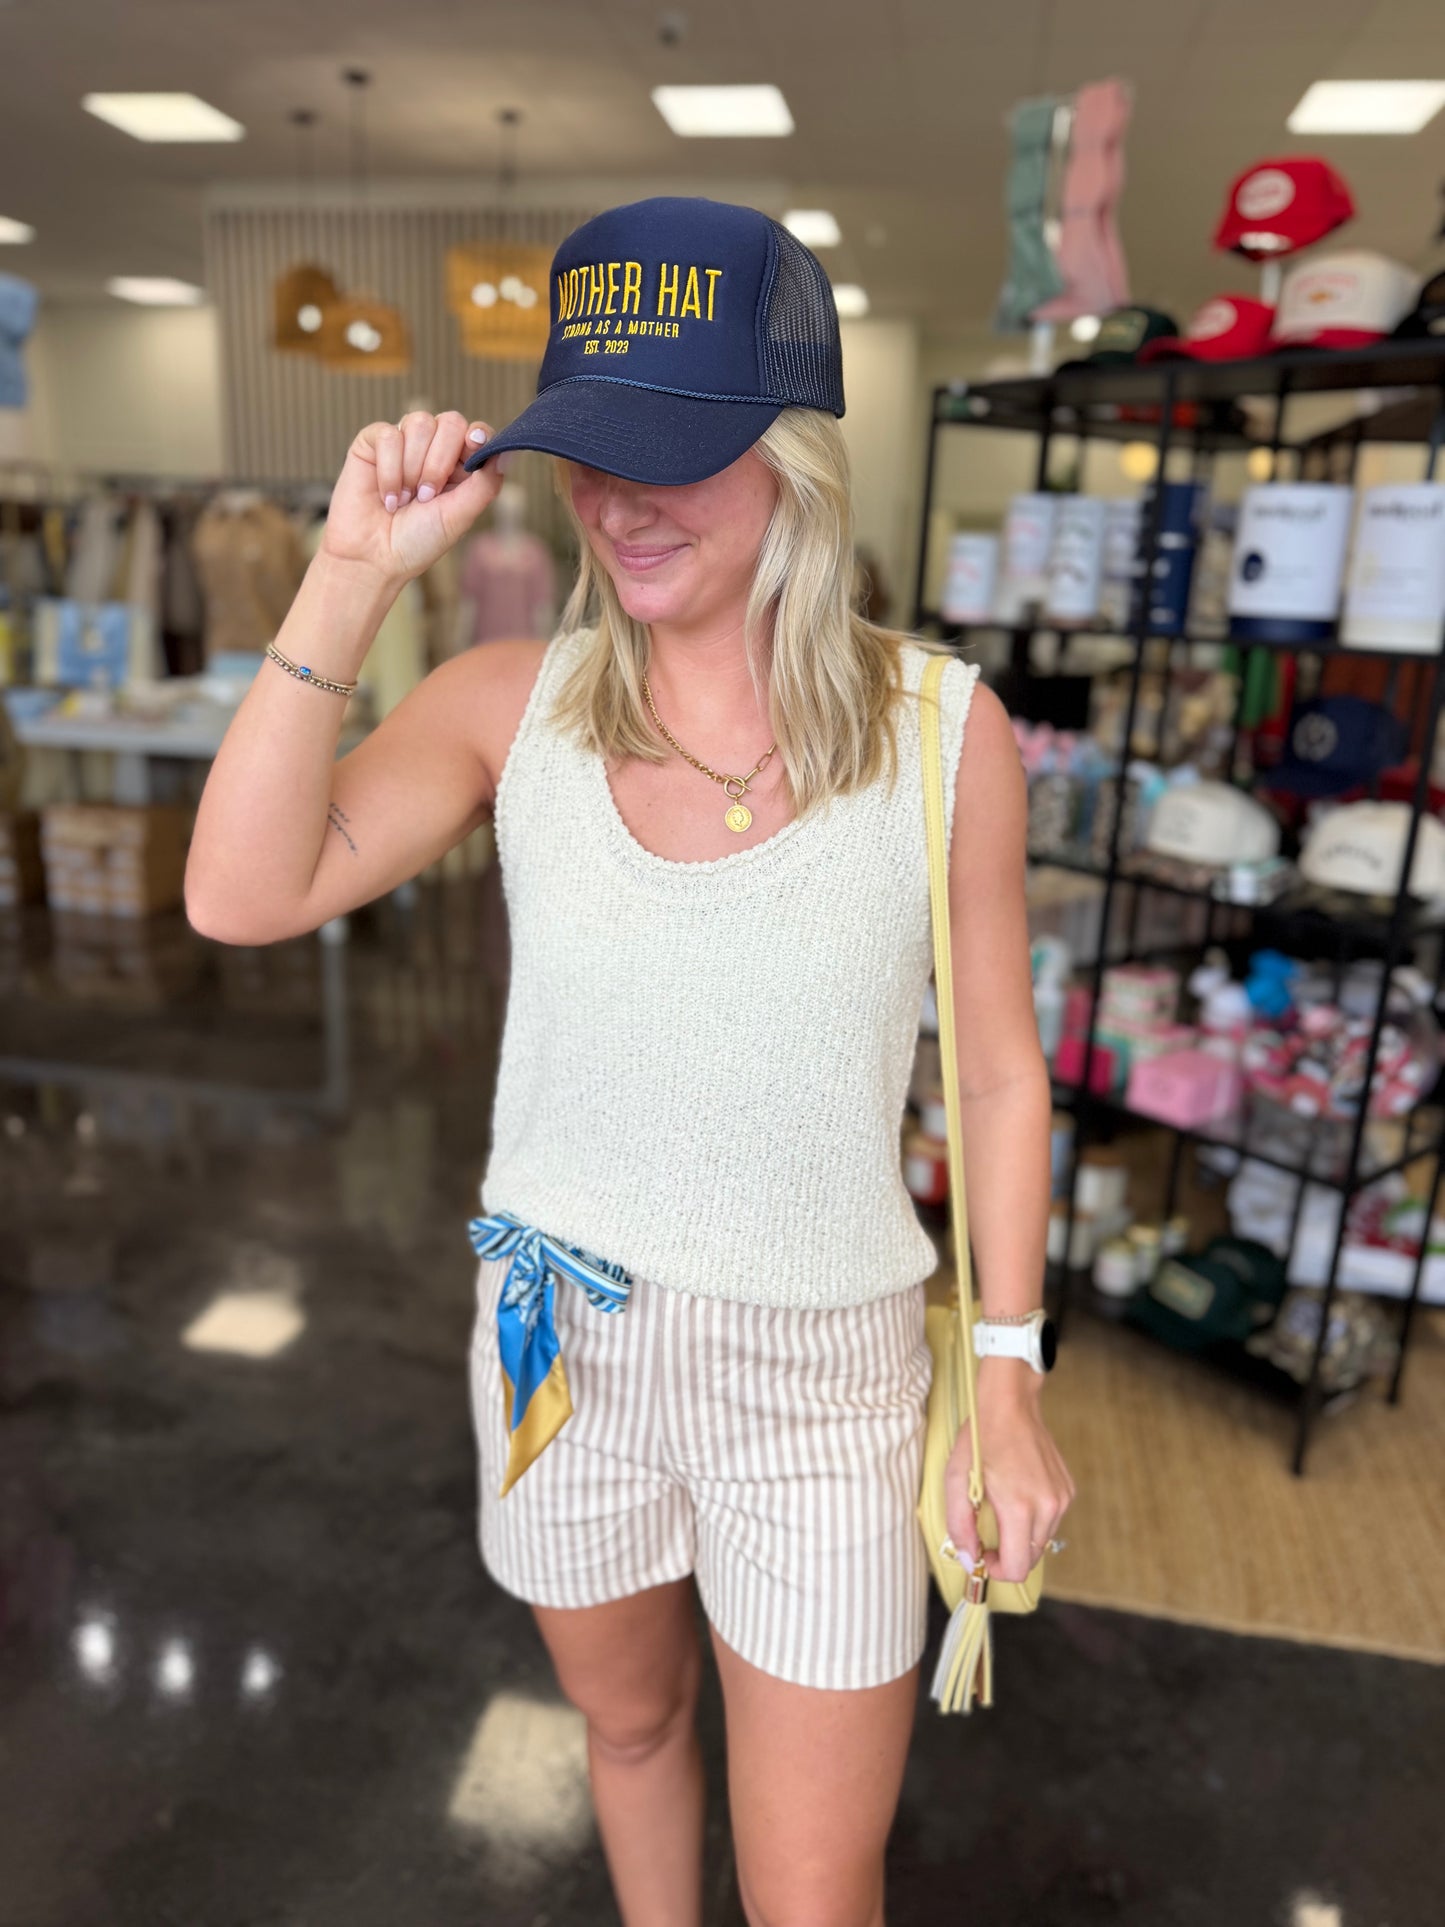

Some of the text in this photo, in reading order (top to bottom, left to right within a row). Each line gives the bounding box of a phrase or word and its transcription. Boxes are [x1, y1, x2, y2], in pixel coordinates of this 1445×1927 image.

[657, 262, 722, 321] HAT
[562, 319, 680, 341] STRONG AS A MOTHER
[584, 339, 629, 355] EST. 2023
